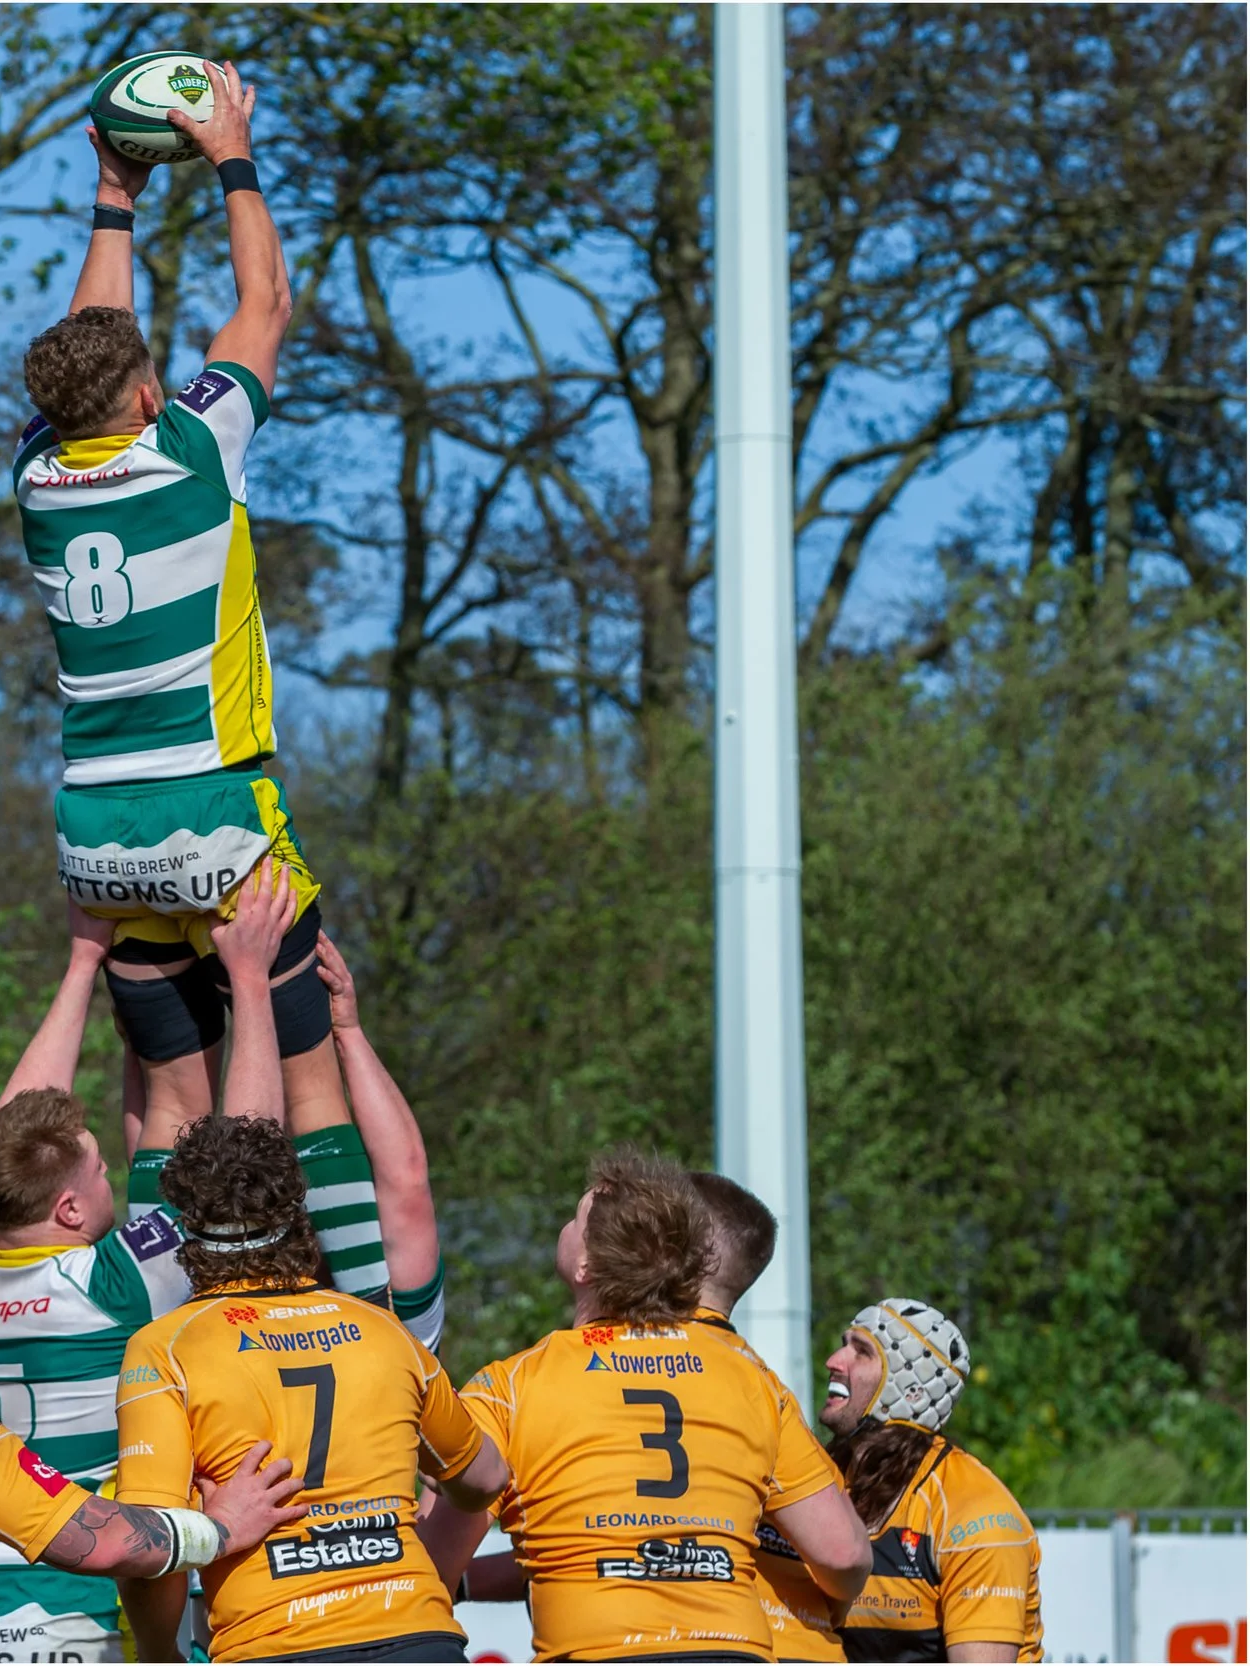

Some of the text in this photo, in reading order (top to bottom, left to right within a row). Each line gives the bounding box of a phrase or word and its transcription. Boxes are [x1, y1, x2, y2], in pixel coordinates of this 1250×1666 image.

[170, 78, 208, 91] RAIDERS
[118, 140, 203, 161] GILB
[64, 531, 133, 629] 8
[60, 852, 105, 874] LITTLE
[108, 860, 136, 876] BIG
[139, 855, 184, 875] BREW
[59, 867, 236, 903] OTTOMS UP
[263, 1303, 341, 1320] JENNER
[259, 1320, 362, 1353] towergate
[610, 1351, 704, 1379] towergate
[278, 1363, 336, 1491] 7
[622, 1388, 690, 1499] 3
[306, 1496, 401, 1518] RDGOULD
[272, 1535, 399, 1573] Estates
[643, 1542, 729, 1563] Quinn
[882, 1593, 921, 1609] Travel
